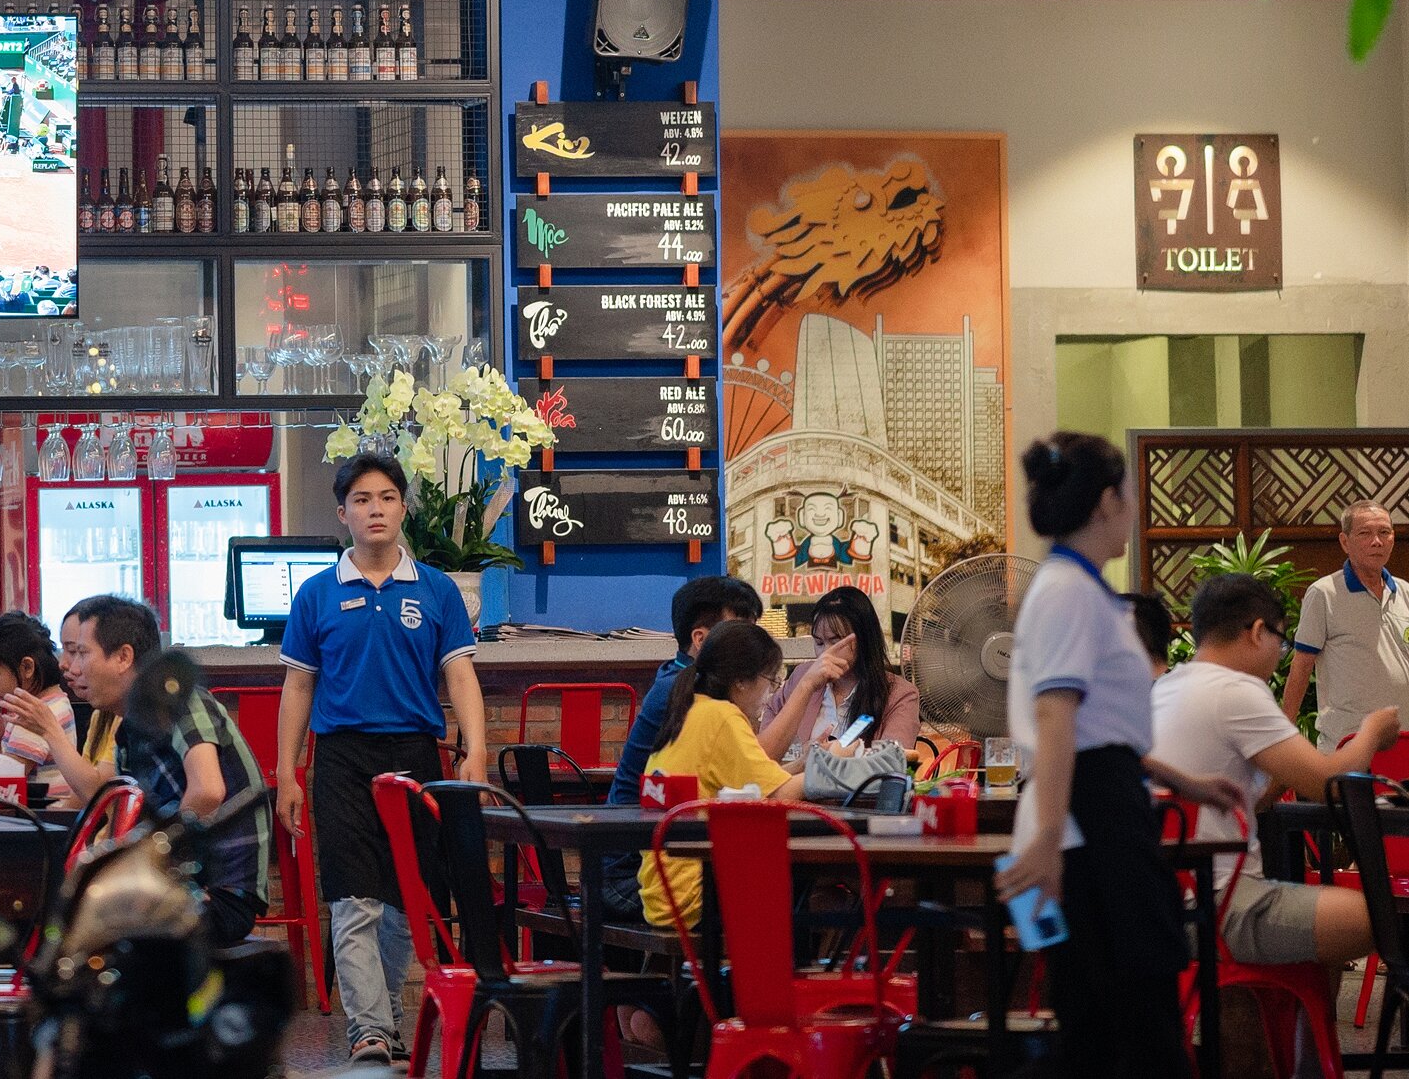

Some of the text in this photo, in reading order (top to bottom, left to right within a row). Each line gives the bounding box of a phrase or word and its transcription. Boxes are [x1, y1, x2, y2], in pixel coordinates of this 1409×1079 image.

[660, 111, 702, 125] WEIZEN
[664, 128, 682, 139] ABV:
[607, 203, 704, 218] PACIFIC PALE ALE
[664, 220, 704, 231] ABV: 5.2%
[1161, 246, 1259, 272] TOILET
[601, 294, 705, 309] BLACK FOREST ALE
[665, 310, 705, 322] ABV: 4.9%
[662, 323, 707, 350] 42.000
[660, 386, 705, 400] RED ALE
[667, 403, 705, 414] ABV: 6.8%
[661, 417, 704, 442] 60.000
[76, 501, 115, 510] ALASKA
[204, 499, 243, 508] ALASKA
[667, 493, 708, 505] ABV: 4.6%
[662, 507, 712, 536] 48.000
